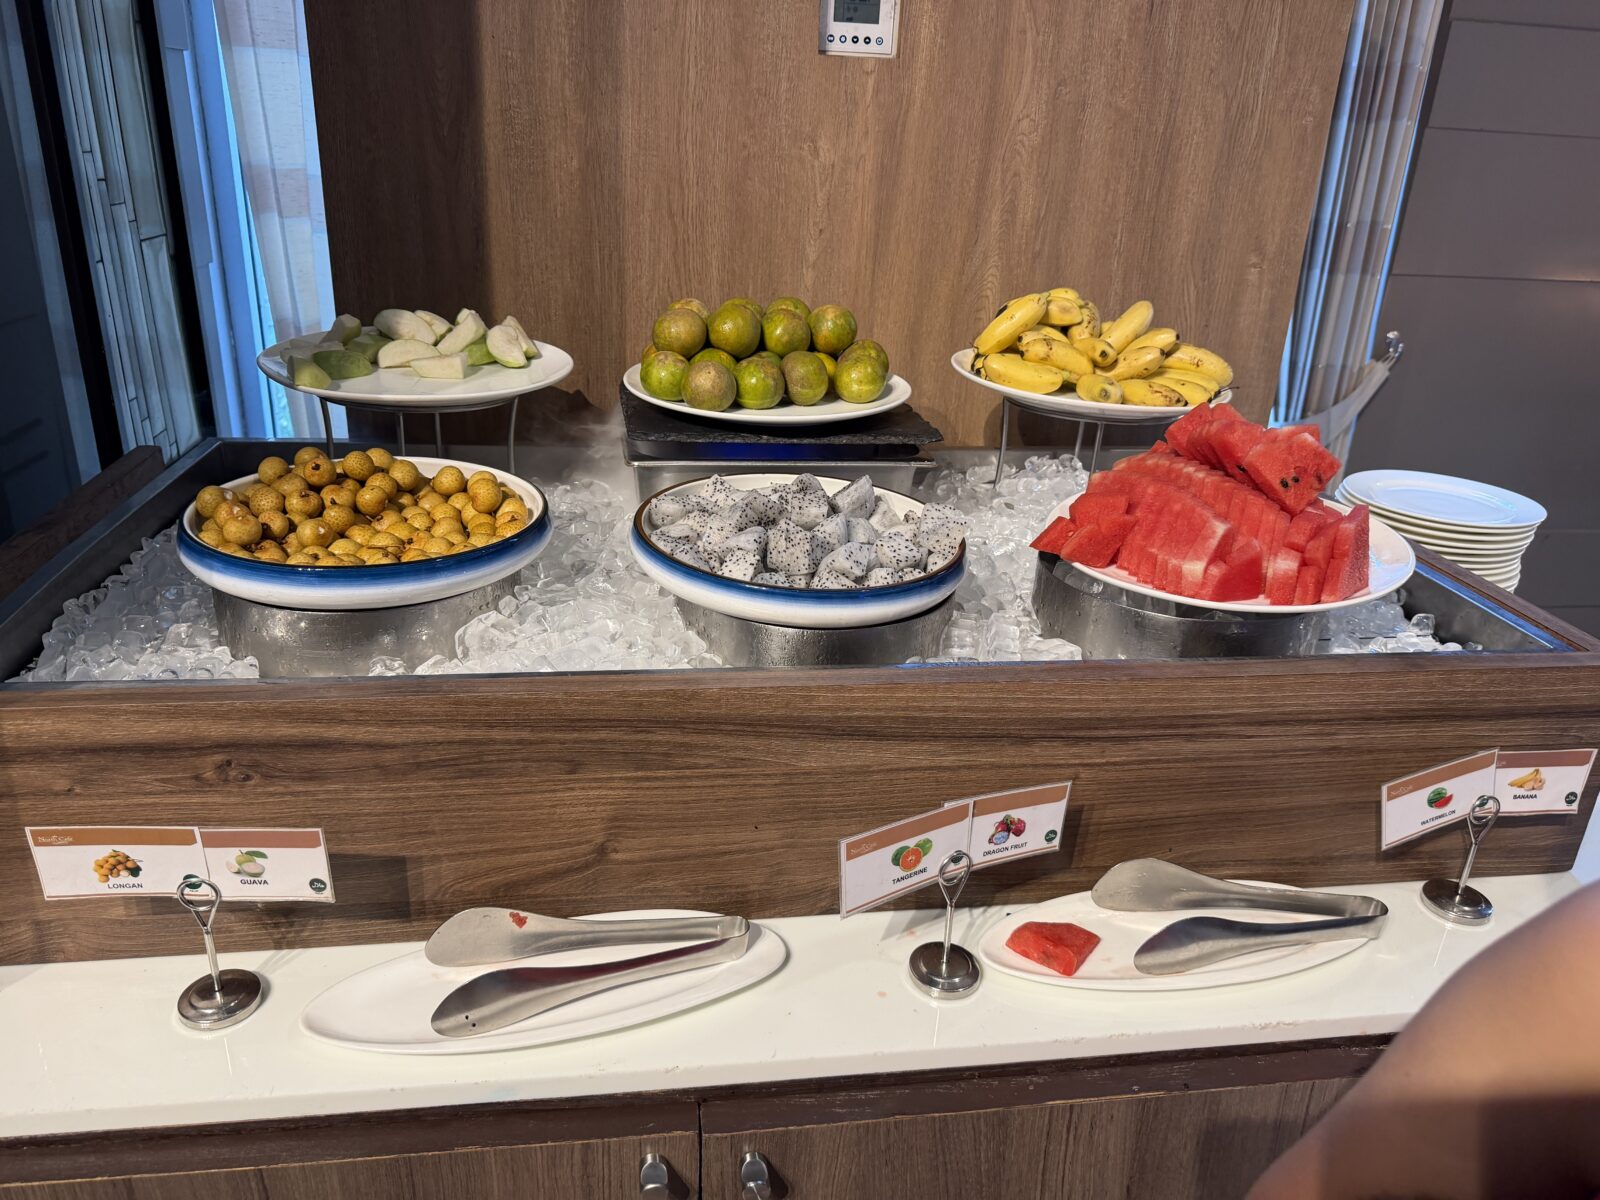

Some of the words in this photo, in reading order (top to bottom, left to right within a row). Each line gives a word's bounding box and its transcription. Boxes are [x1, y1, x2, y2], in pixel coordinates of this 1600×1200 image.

[1420, 809, 1456, 826] WATERMELON
[982, 845, 1009, 857] DRAGON
[1010, 841, 1028, 851] FRUIT
[892, 866, 928, 885] TANGERINE
